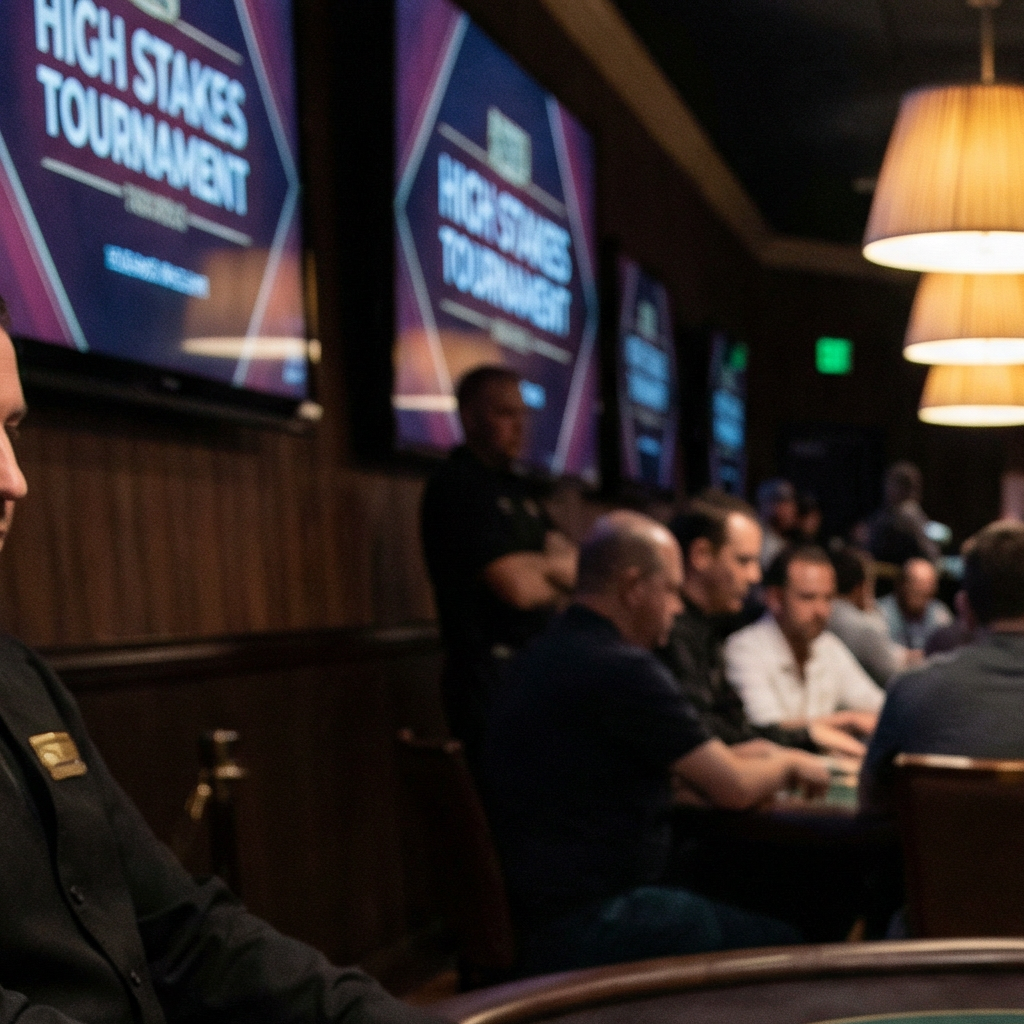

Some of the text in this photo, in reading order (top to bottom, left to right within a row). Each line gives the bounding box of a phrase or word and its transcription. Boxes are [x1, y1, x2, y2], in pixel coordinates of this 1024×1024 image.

[34, 0, 249, 149] HIGH STAKES
[36, 63, 250, 216] TOURNAMENT
